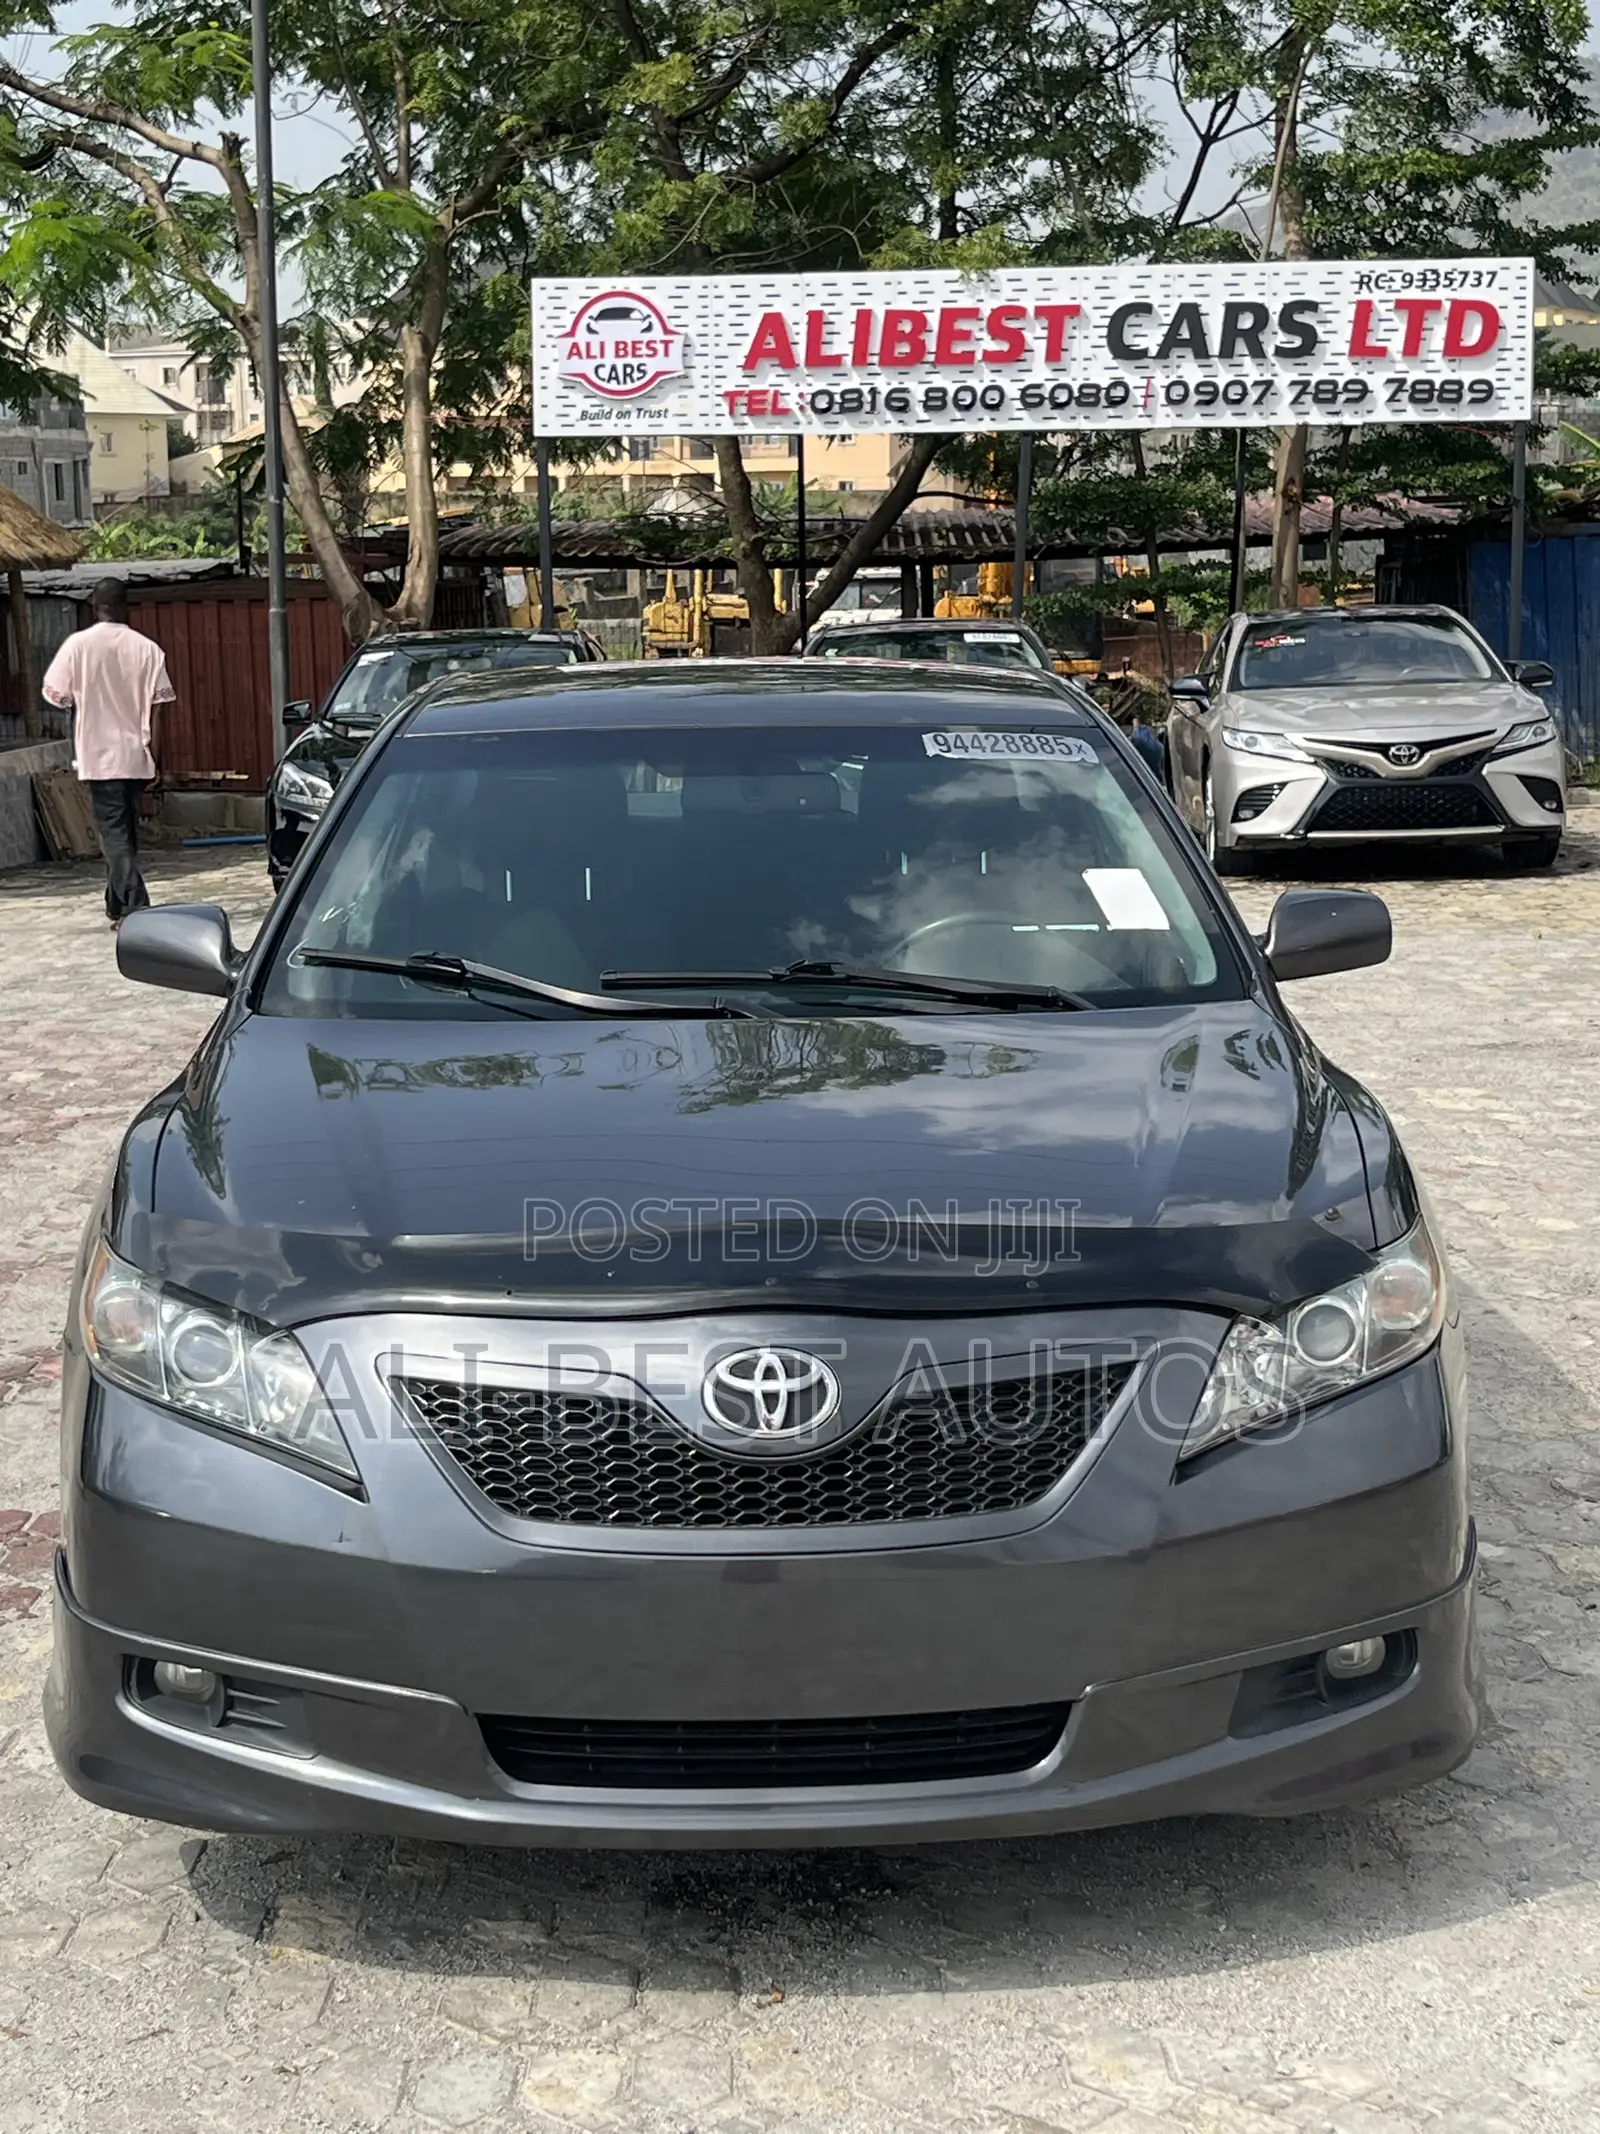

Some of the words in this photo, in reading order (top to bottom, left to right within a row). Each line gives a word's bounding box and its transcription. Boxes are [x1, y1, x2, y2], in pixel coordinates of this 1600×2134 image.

[1398, 271, 1499, 289] 9335737
[742, 303, 1082, 370] ALIBEST
[1106, 300, 1320, 361] CARS
[1347, 298, 1500, 359] LTD
[566, 340, 606, 361] ALI
[614, 339, 674, 359] BEST
[594, 362, 648, 386] CARS
[808, 386, 912, 415] 0816
[921, 384, 1006, 413] 800
[1019, 381, 1131, 411] 6080
[1163, 379, 1275, 406] 0907
[1288, 379, 1371, 406] 789
[1383, 377, 1495, 405] 7889
[580, 408, 614, 422] Build
[615, 409, 632, 420] on
[636, 407, 669, 420] Trust
